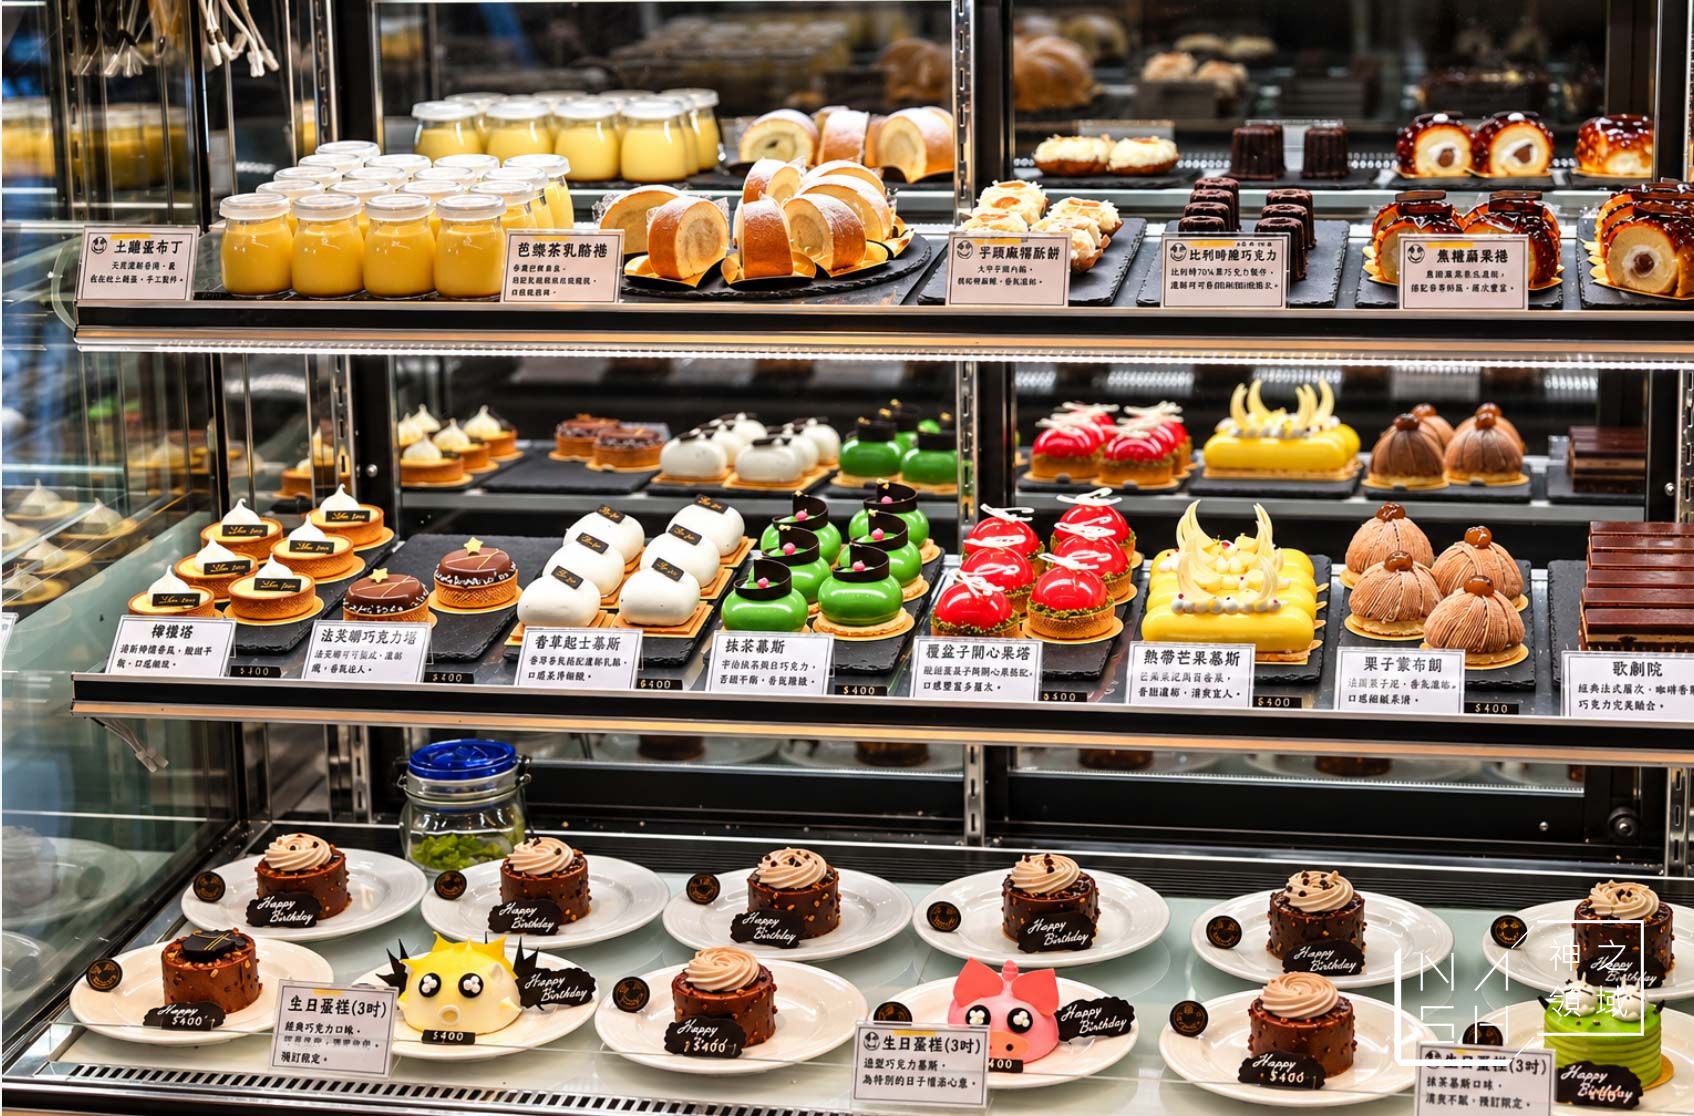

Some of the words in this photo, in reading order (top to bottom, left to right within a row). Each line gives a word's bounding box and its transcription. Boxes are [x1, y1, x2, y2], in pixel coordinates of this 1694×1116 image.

[926, 644, 1031, 661] 覆盆子開心果塔
[1144, 650, 1240, 666] 熱帶芒果慕斯
[1613, 661, 1663, 677] 歌劇院
[843, 686, 876, 695] $400
[1474, 703, 1508, 714] $400
[257, 896, 297, 914] Happy
[499, 902, 538, 918] Happy
[742, 912, 780, 928] Happy
[1027, 918, 1067, 935] Happy
[1293, 946, 1334, 962] Happy
[525, 973, 566, 990] Happy
[157, 1004, 199, 1019] Happy
[1060, 1004, 1103, 1021] Happy
[432, 1031, 465, 1041] $400
[677, 1018, 719, 1038] Happy
[1252, 1053, 1297, 1073] Happy
[1561, 1065, 1608, 1083] Happy
